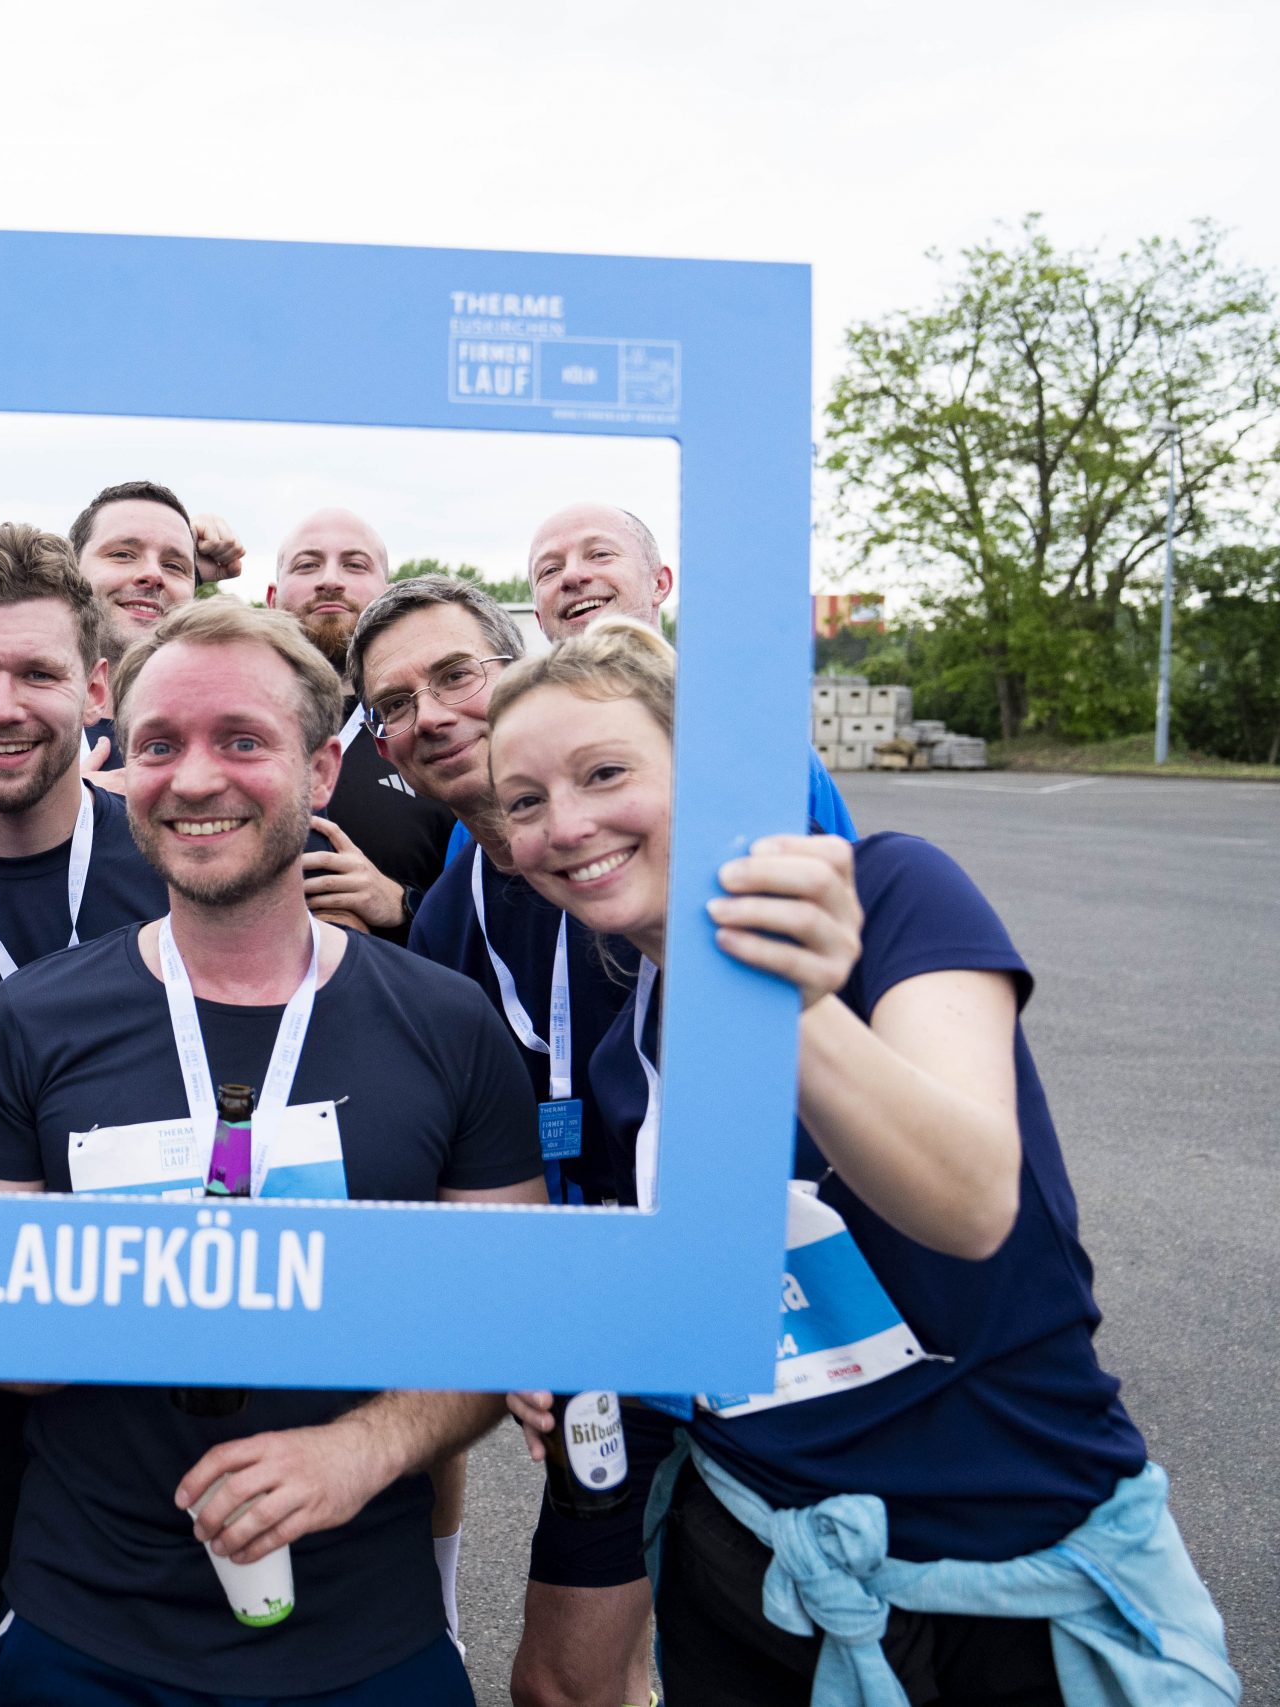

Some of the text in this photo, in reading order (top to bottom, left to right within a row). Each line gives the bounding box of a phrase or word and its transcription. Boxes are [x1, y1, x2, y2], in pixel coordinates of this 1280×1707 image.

[451, 291, 564, 318] THERME
[458, 341, 531, 364] FIRMEN
[458, 363, 531, 396] LAUF
[540, 1105, 567, 1114] THERME
[158, 1127, 194, 1138] THERM
[542, 1128, 564, 1139] LAUF
